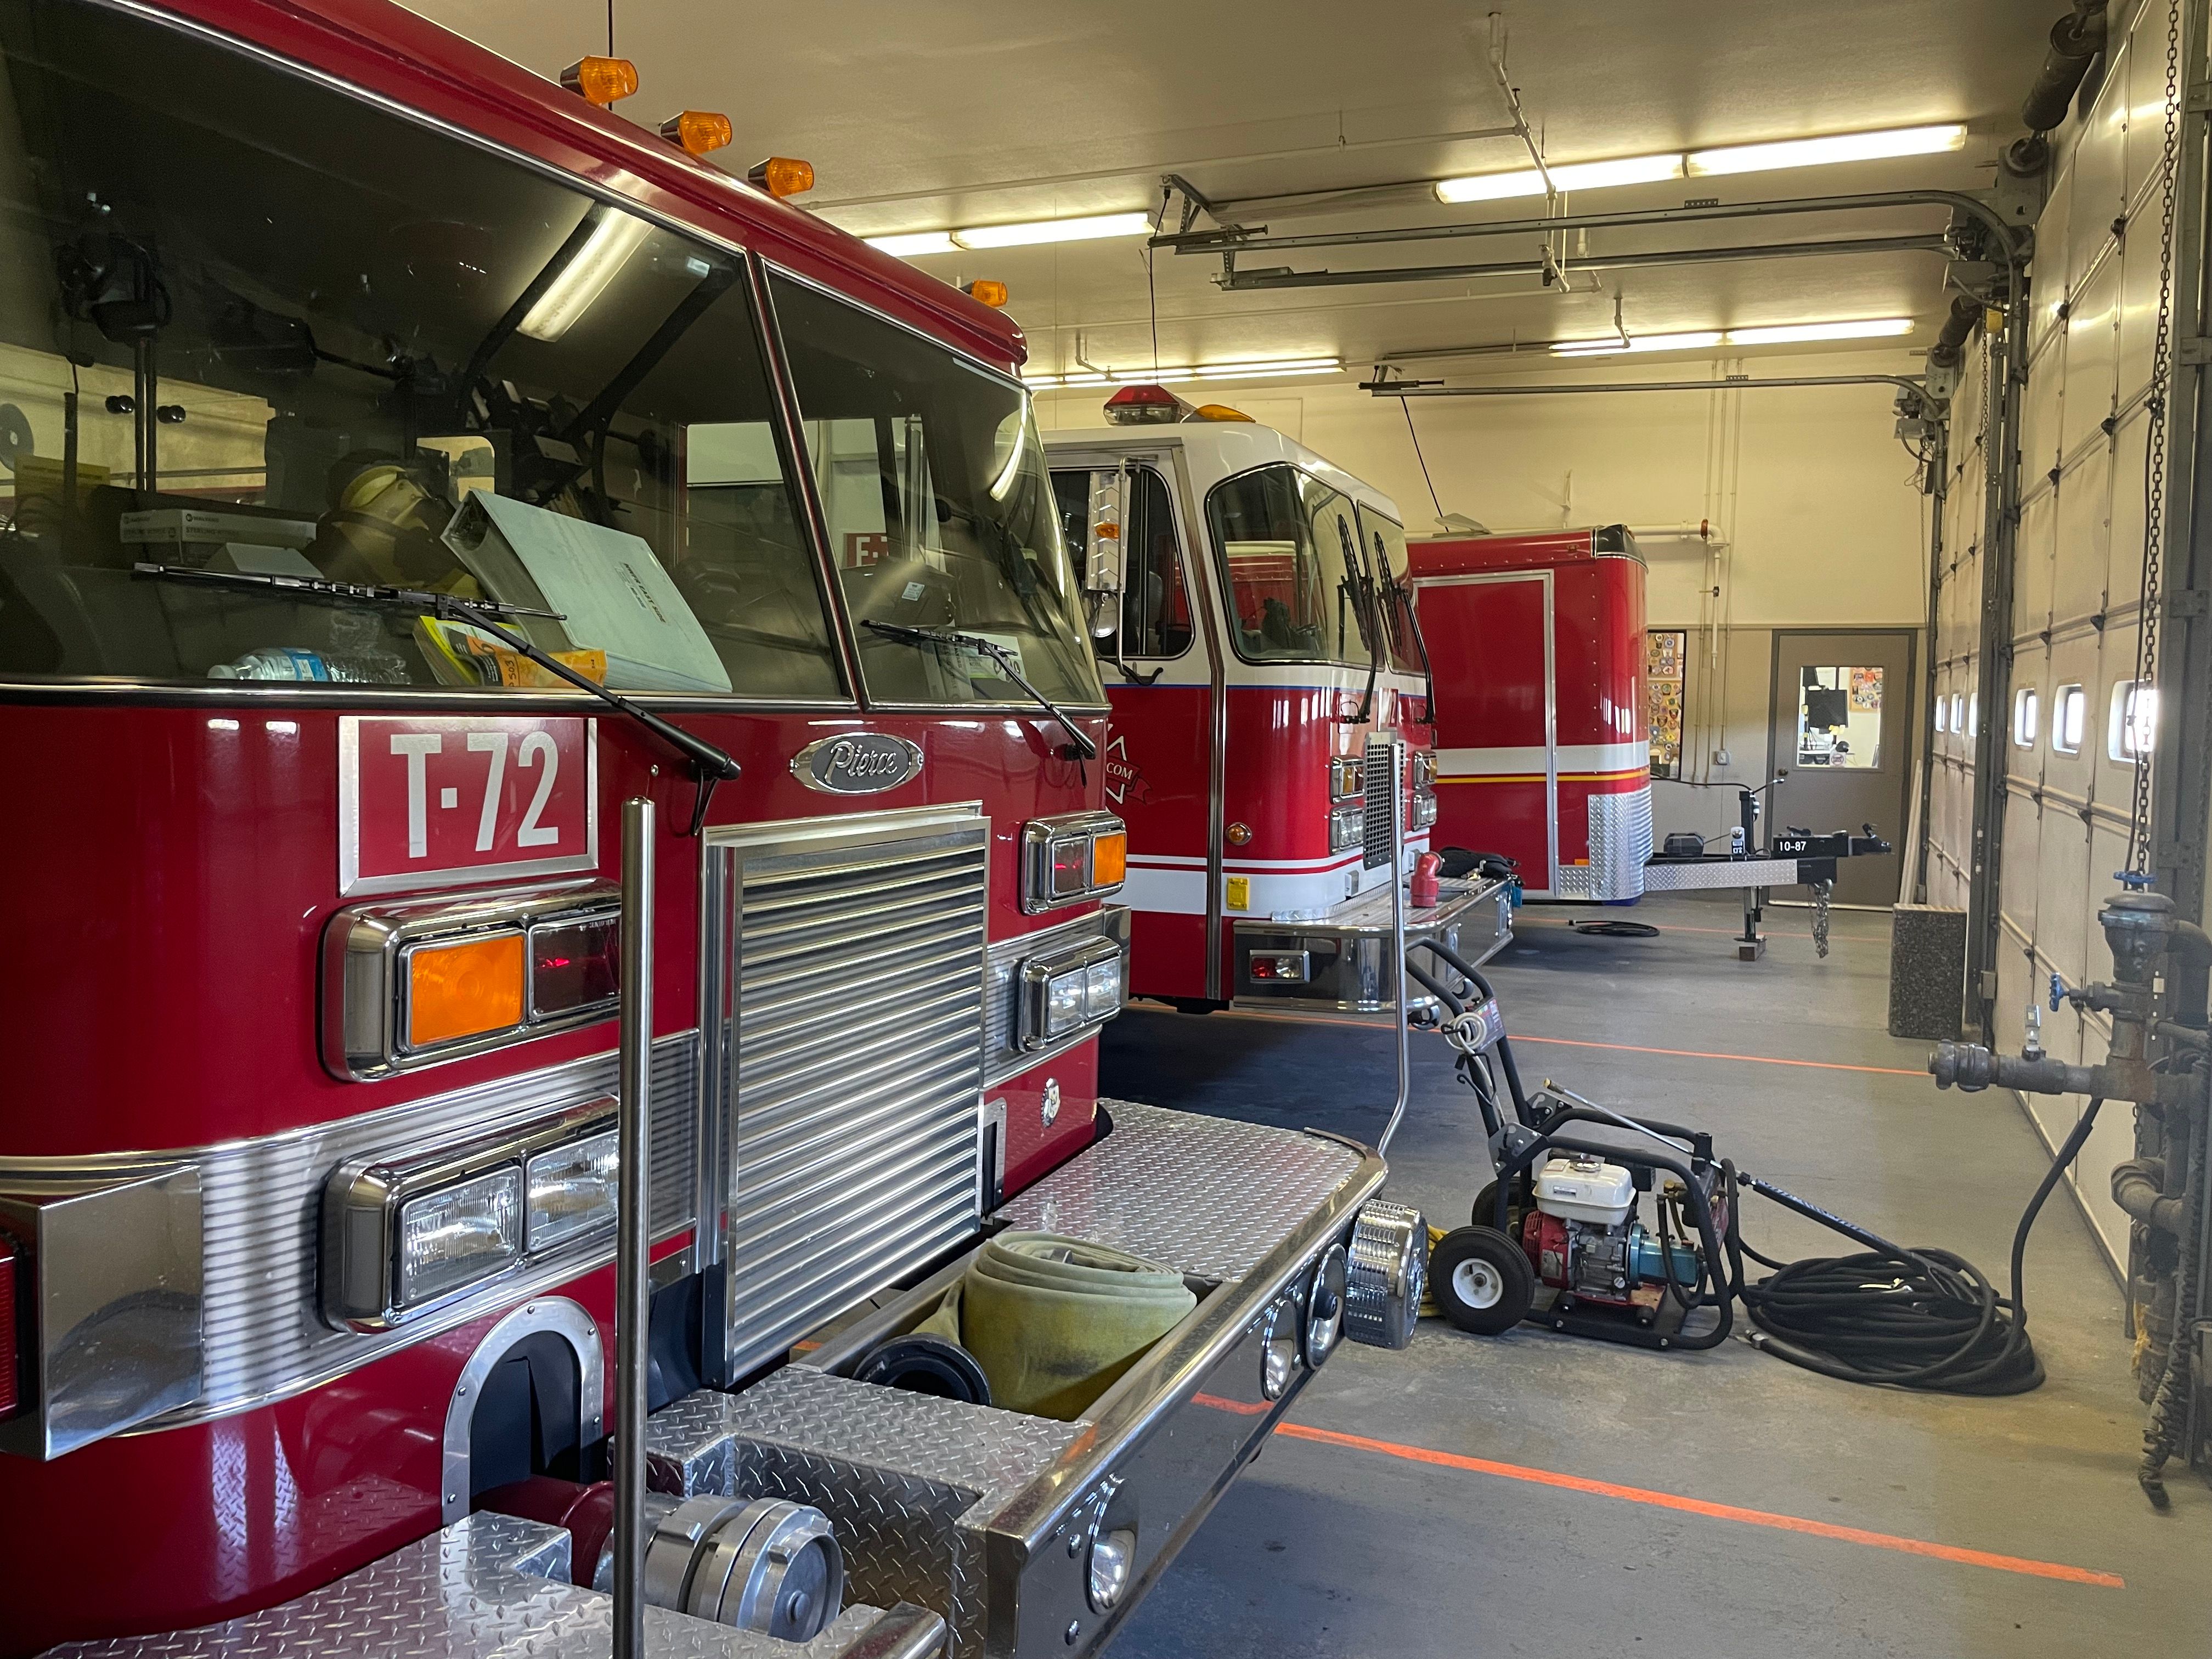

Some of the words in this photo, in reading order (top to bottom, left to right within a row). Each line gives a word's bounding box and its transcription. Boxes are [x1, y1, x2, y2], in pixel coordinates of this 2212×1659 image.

[639, 585, 654, 604] EAST
[825, 741, 898, 785] Pierce
[1779, 840, 1807, 851] 10-87
